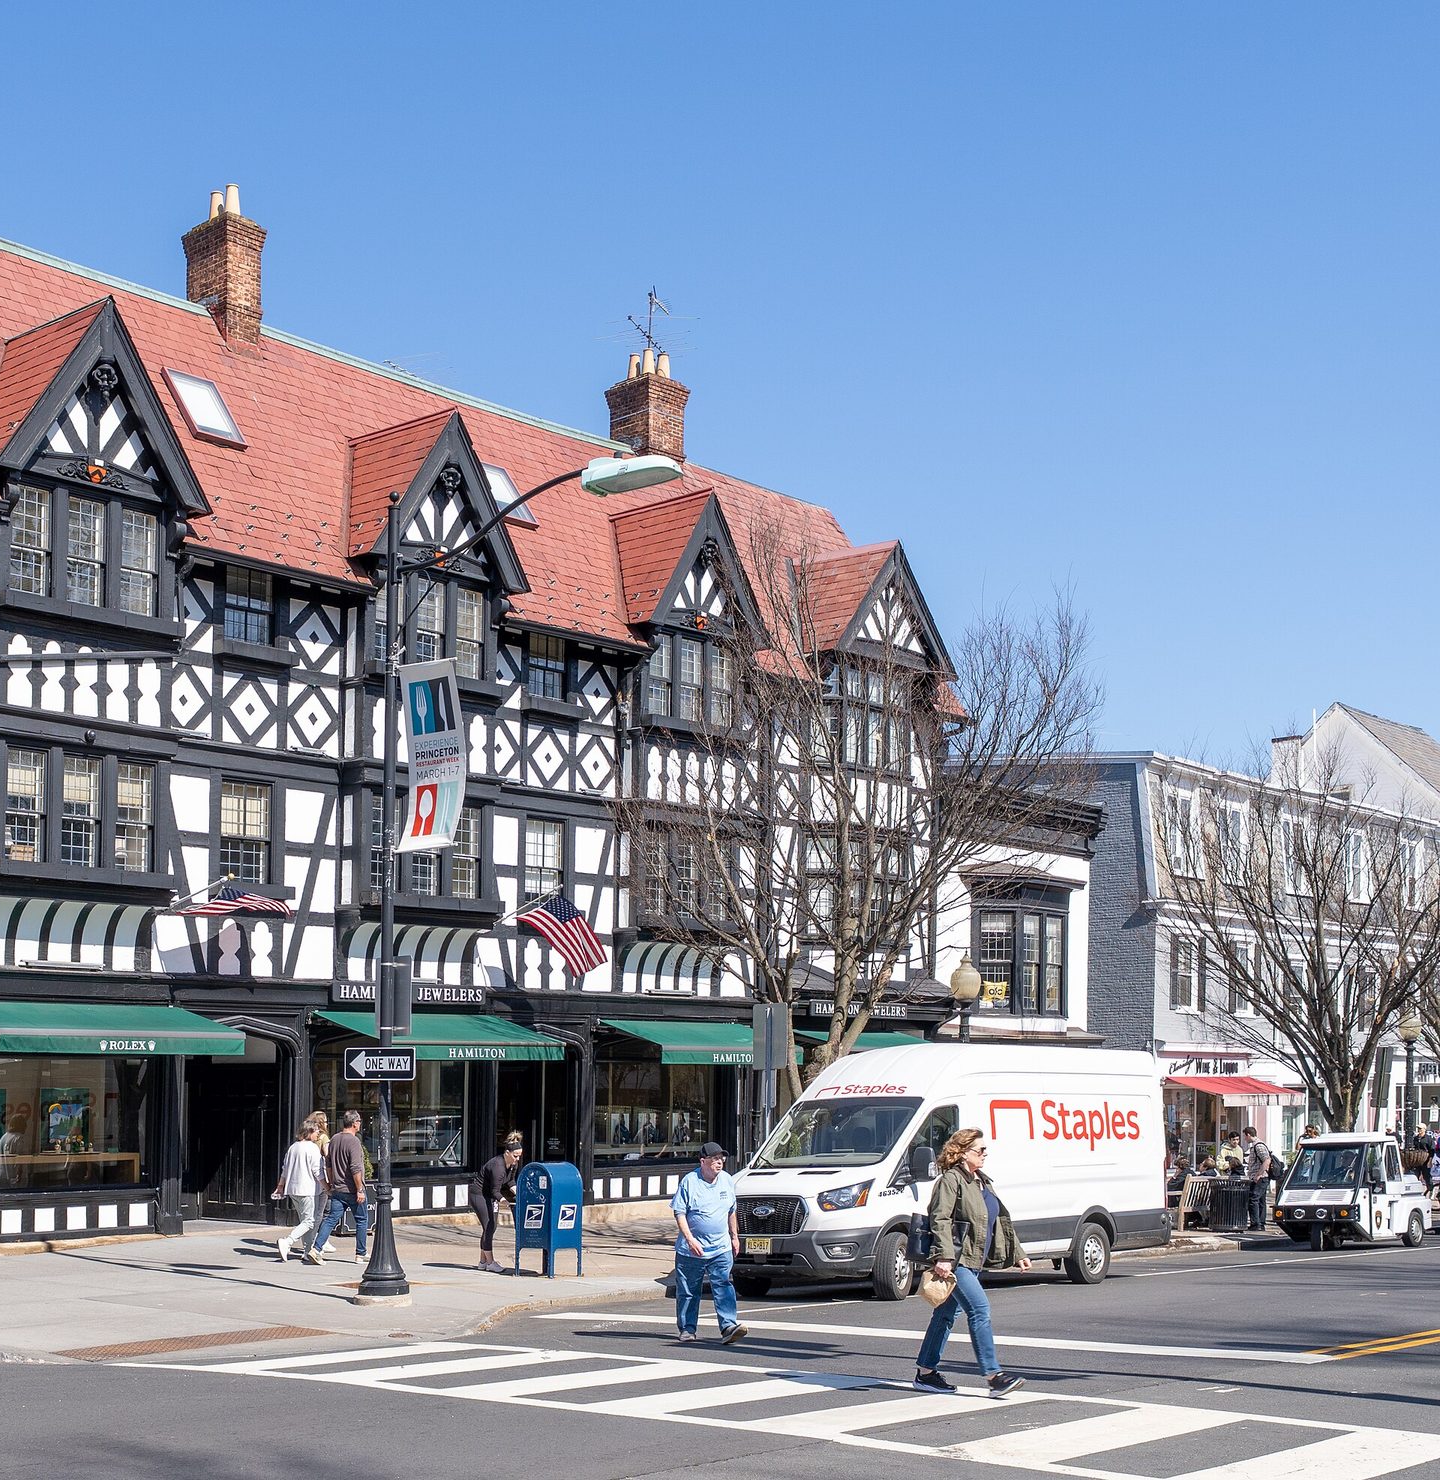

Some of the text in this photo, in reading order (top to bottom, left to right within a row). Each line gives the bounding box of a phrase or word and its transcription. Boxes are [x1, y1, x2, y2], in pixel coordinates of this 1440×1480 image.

[414, 737, 458, 750] EXPERIENCE
[415, 746, 460, 760] PRINCETON
[416, 758, 445, 767] RESTAURANT
[416, 766, 460, 780] MARCH 1-7
[340, 984, 482, 1002] HAMI JEWELERS
[815, 1003, 860, 1014] HAMON
[109, 1040, 147, 1050] ROLEX
[448, 1048, 506, 1058] HAMILTON
[364, 1058, 410, 1070] ONE WAY
[1212, 1058, 1218, 1074] &
[841, 1084, 908, 1095] Staples
[1040, 1100, 1140, 1151] Staples
